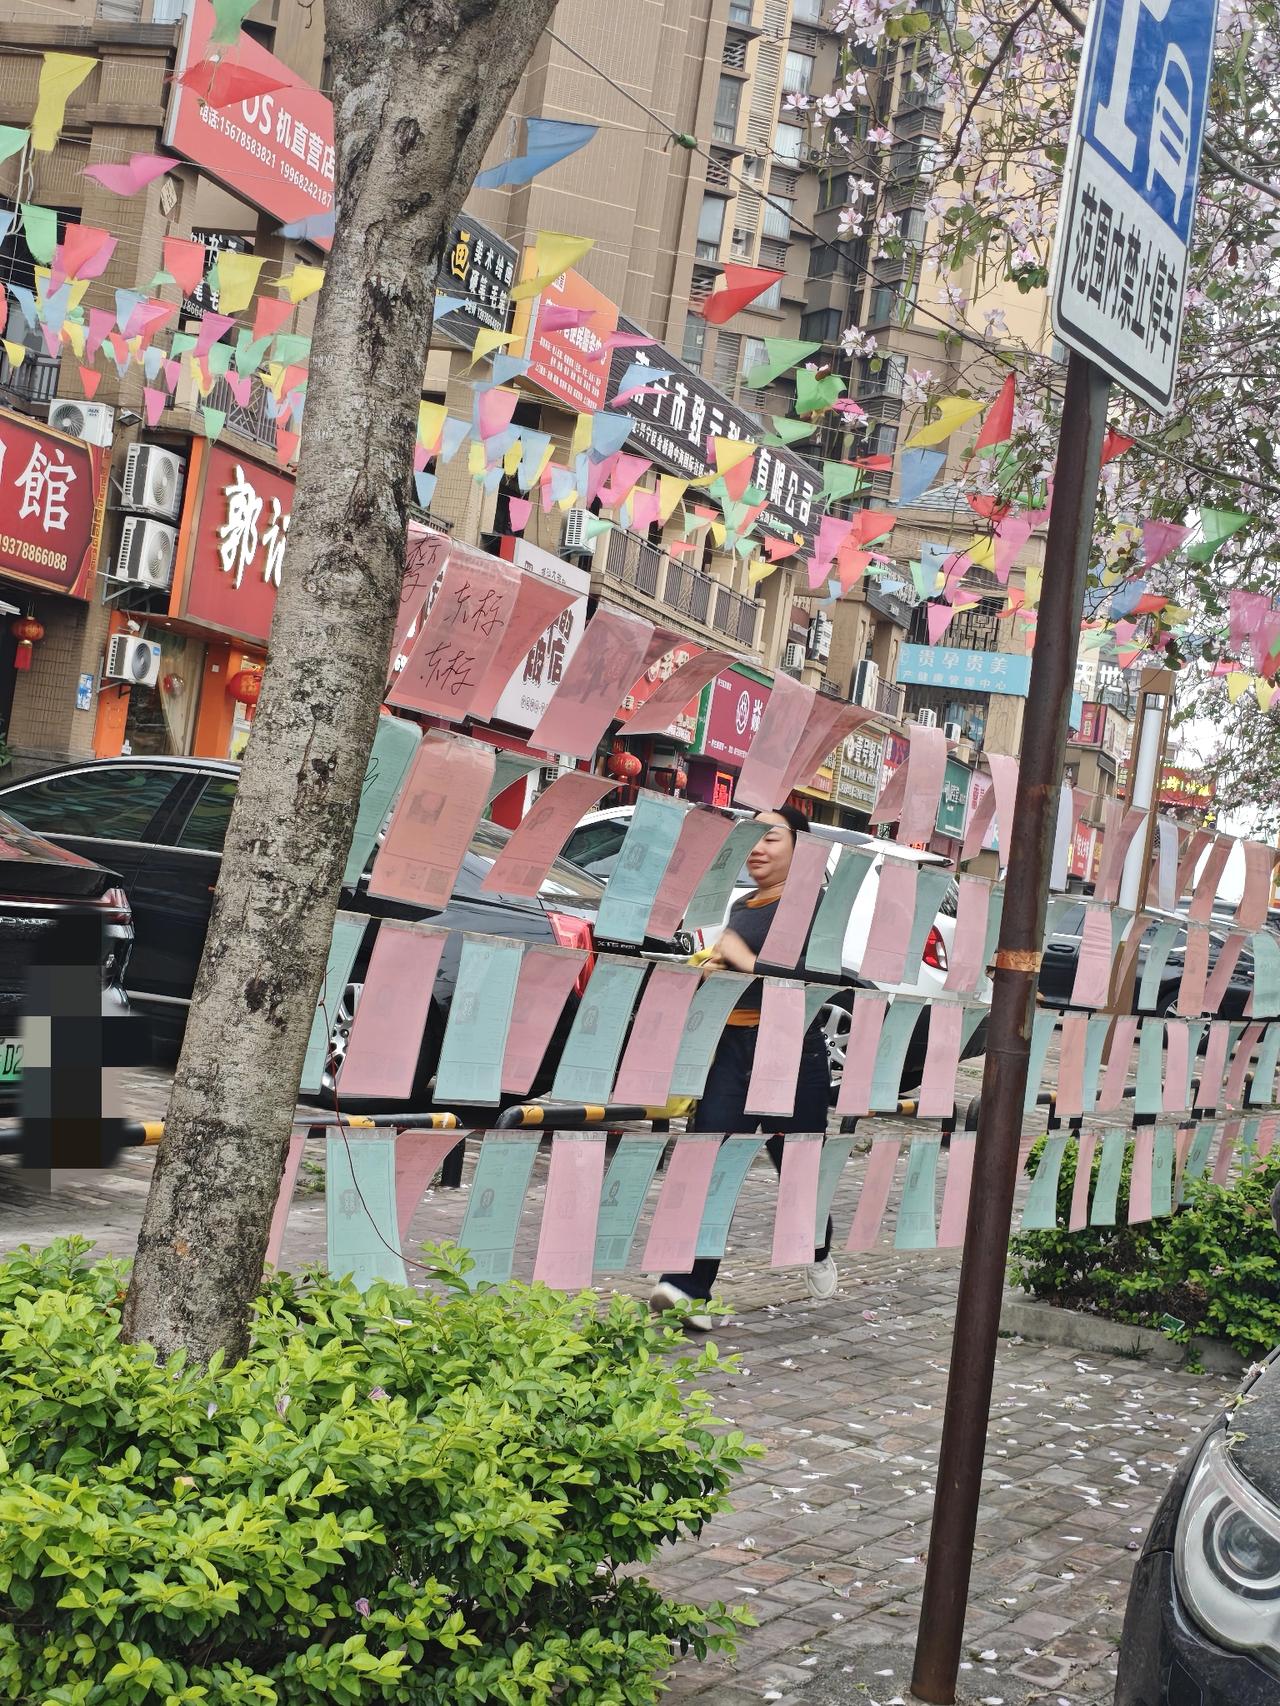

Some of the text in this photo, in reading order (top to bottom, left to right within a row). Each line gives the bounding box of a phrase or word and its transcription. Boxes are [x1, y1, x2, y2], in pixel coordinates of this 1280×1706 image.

[227, 93, 335, 182] OS机直营店
[280, 161, 331, 208] 19968242187
[183, 298, 206, 318] 78664
[1071, 182, 1178, 364] 范围内禁止停车
[0, 440, 77, 533] 館
